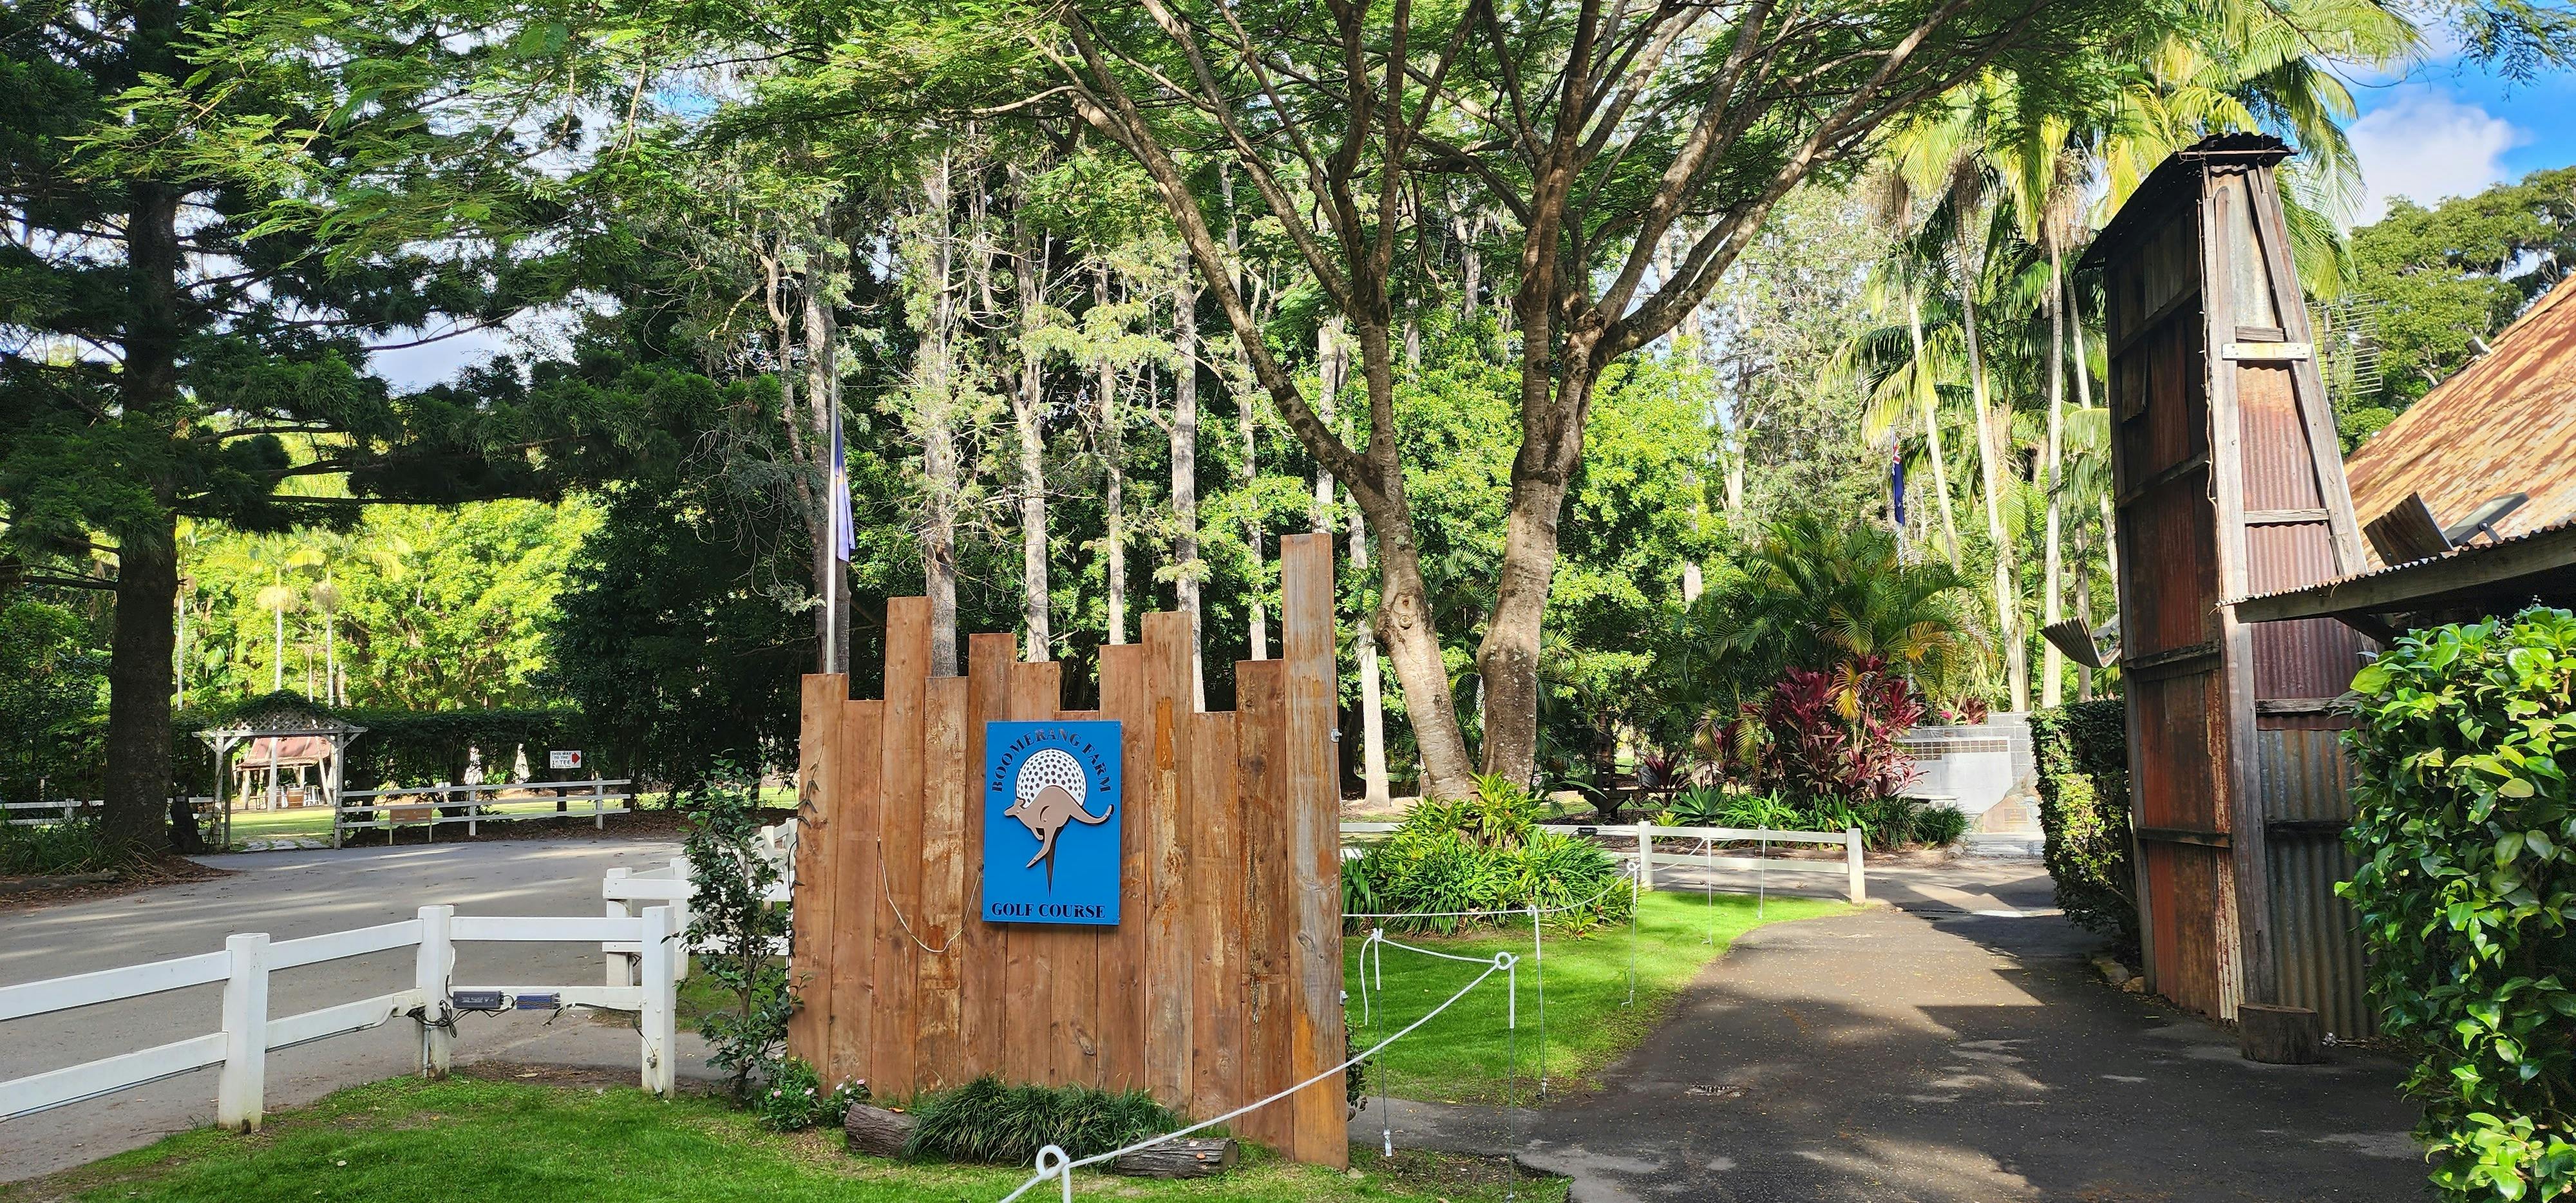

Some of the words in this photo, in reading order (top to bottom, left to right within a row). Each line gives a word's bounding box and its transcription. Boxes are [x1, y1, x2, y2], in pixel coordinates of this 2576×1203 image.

[992, 728, 1081, 792] BOOMERANG
[1082, 743, 1112, 793] FARM
[991, 902, 1034, 916] GOLF
[1038, 904, 1106, 918] COURSE
